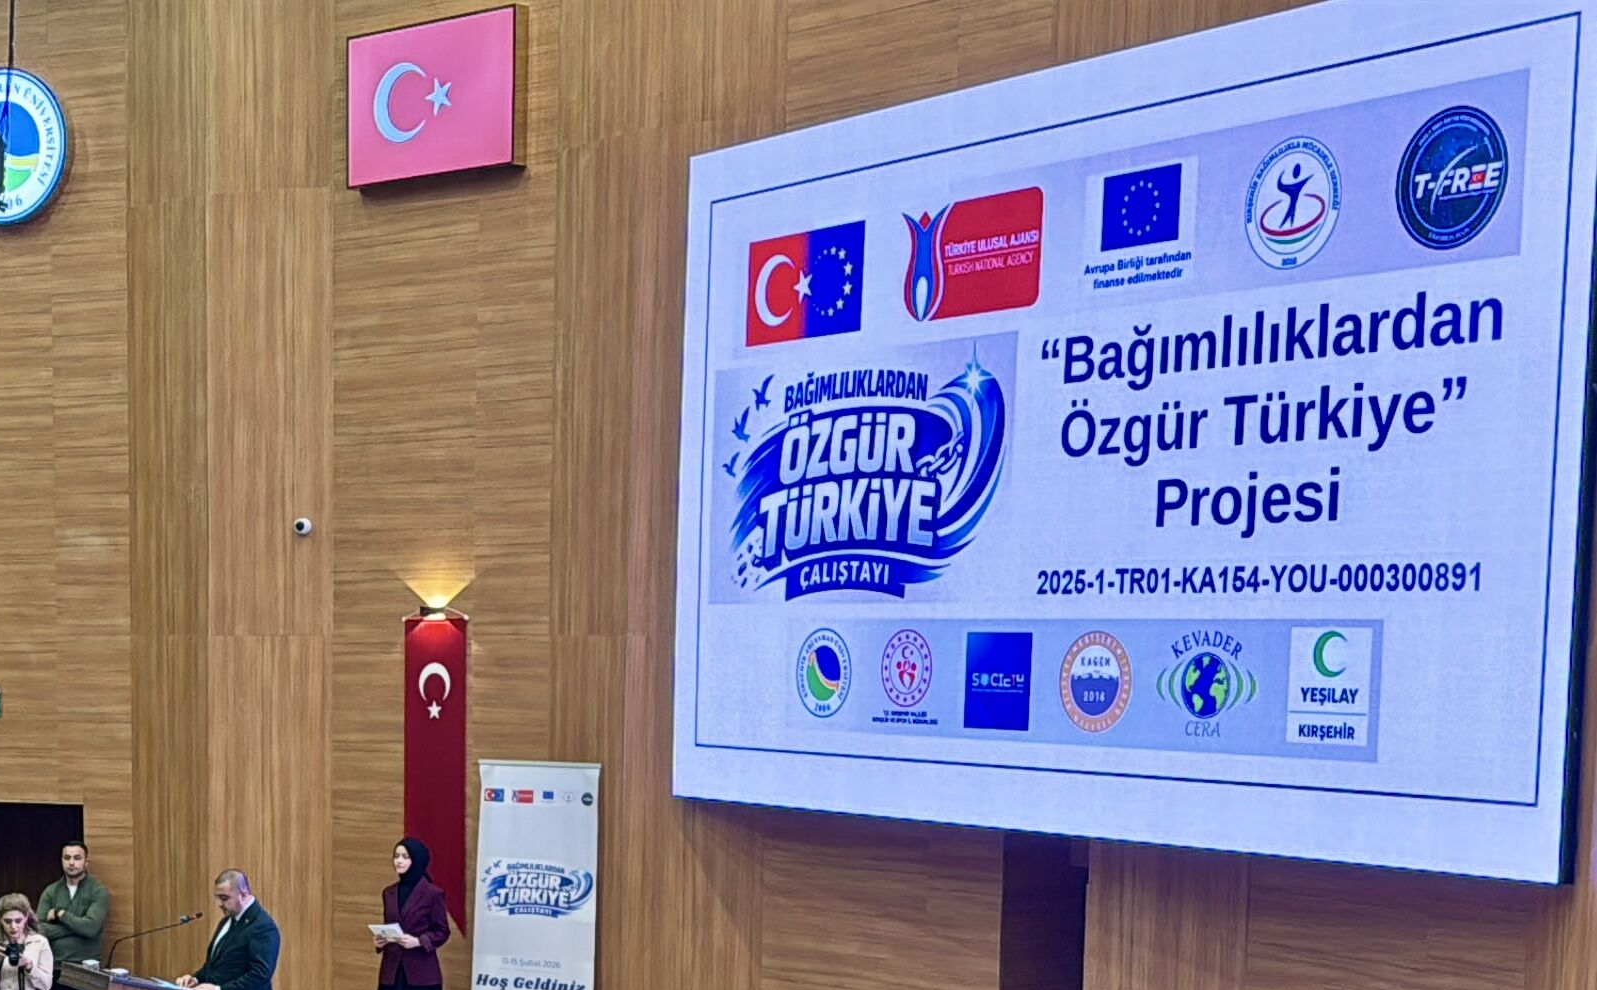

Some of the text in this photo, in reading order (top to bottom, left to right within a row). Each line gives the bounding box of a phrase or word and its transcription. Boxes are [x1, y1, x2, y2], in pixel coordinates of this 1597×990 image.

[977, 235, 1008, 252] ULUSAL
[1007, 251, 1034, 266] AGENCY
[1084, 250, 1192, 275] Avrupa Birliği tarafından
[1093, 267, 1183, 290] finanse edilmektedir
[1041, 291, 1504, 390] “Bağımlılıklardan
[784, 369, 929, 413] BAĞIMLILIKLARDAN
[1061, 375, 1468, 467] Özgür Türkiye”
[779, 412, 916, 485] ÖZGÜR
[1155, 466, 1341, 539] Projesi
[759, 478, 936, 558] TÜRKİYE
[800, 560, 890, 590] ÇALIŞTAYI
[1036, 562, 1483, 596] 2025-1-TR01-KA154-YOU-000300891
[1170, 630, 1243, 661] KEVADER
[1081, 656, 1111, 667] KAGEM
[1300, 687, 1359, 707] YEŞİLAY
[1184, 720, 1221, 738] CERA
[1298, 722, 1355, 741] KIRŞEHİR
[505, 870, 562, 890] ÖZGÜR
[497, 888, 570, 908] TÜRKİYE
